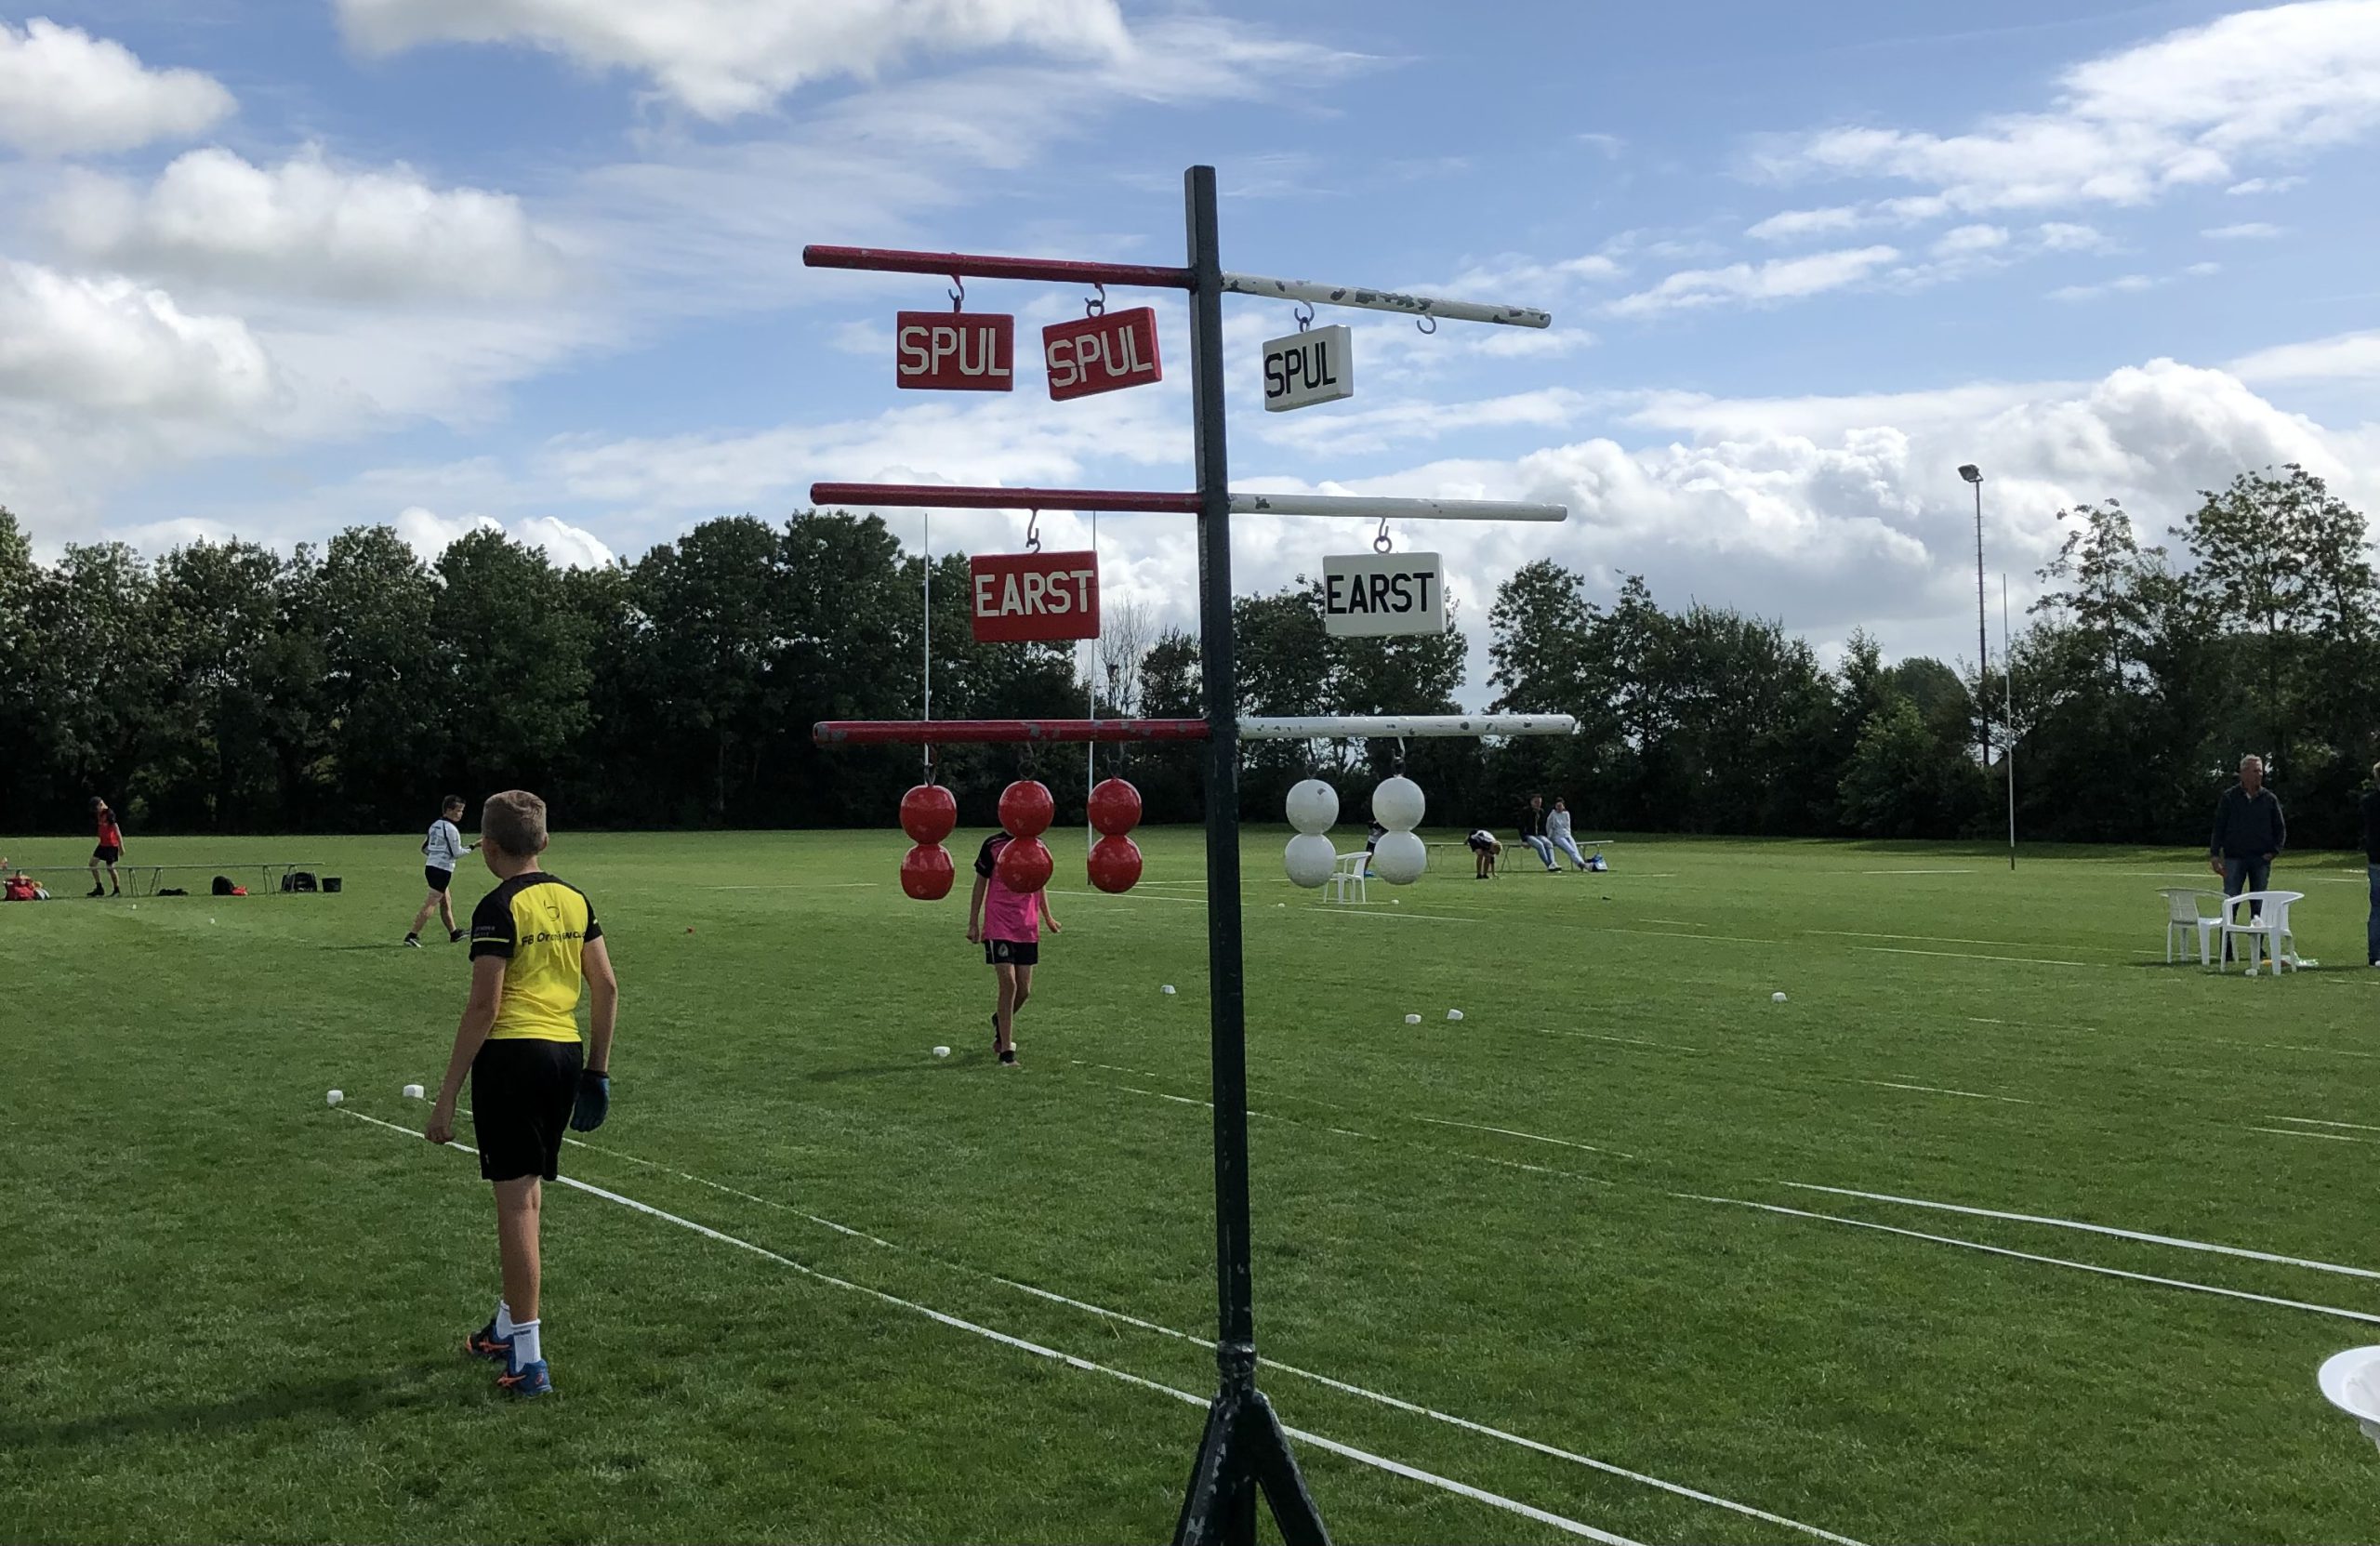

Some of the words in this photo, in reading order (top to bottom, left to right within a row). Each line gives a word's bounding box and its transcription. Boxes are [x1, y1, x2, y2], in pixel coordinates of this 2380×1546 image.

[899, 325, 1010, 377] SPUL
[1047, 325, 1154, 388] SPUL
[1264, 341, 1337, 399] SPUL
[974, 570, 1094, 617] EARST
[1327, 572, 1435, 614] EARST
